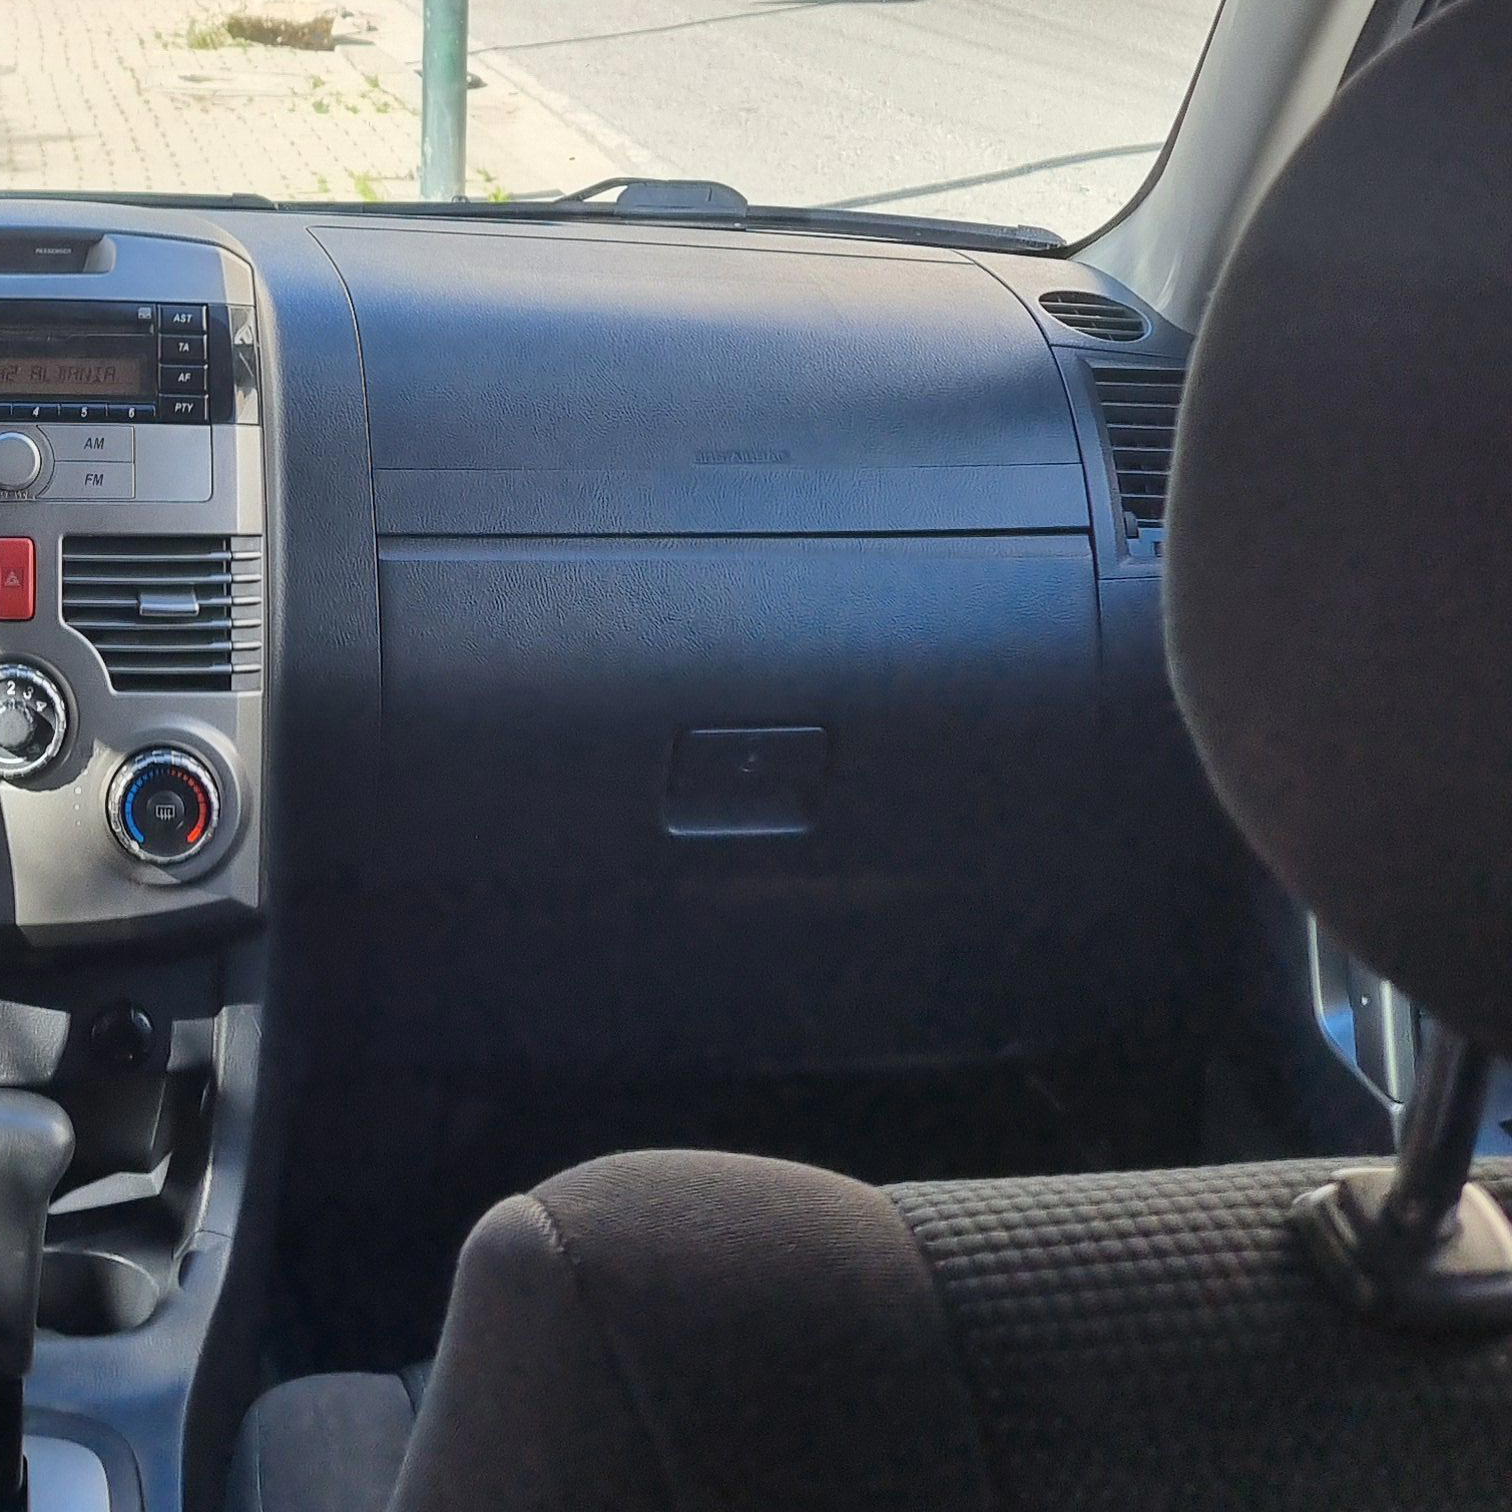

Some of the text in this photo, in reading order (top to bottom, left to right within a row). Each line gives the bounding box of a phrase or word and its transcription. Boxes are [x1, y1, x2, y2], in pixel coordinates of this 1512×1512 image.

[173, 313, 192, 323] AST
[178, 342, 190, 352] TA
[178, 373, 191, 382] AF
[32, 406, 40, 418] 4
[80, 406, 88, 418] 5
[128, 407, 136, 419] 6
[174, 403, 194, 413] PTY
[83, 437, 105, 450] AM
[84, 474, 104, 487] FM
[7, 680, 16, 695] 2
[23, 686, 34, 700] 3
[36, 701, 47, 712] 4
